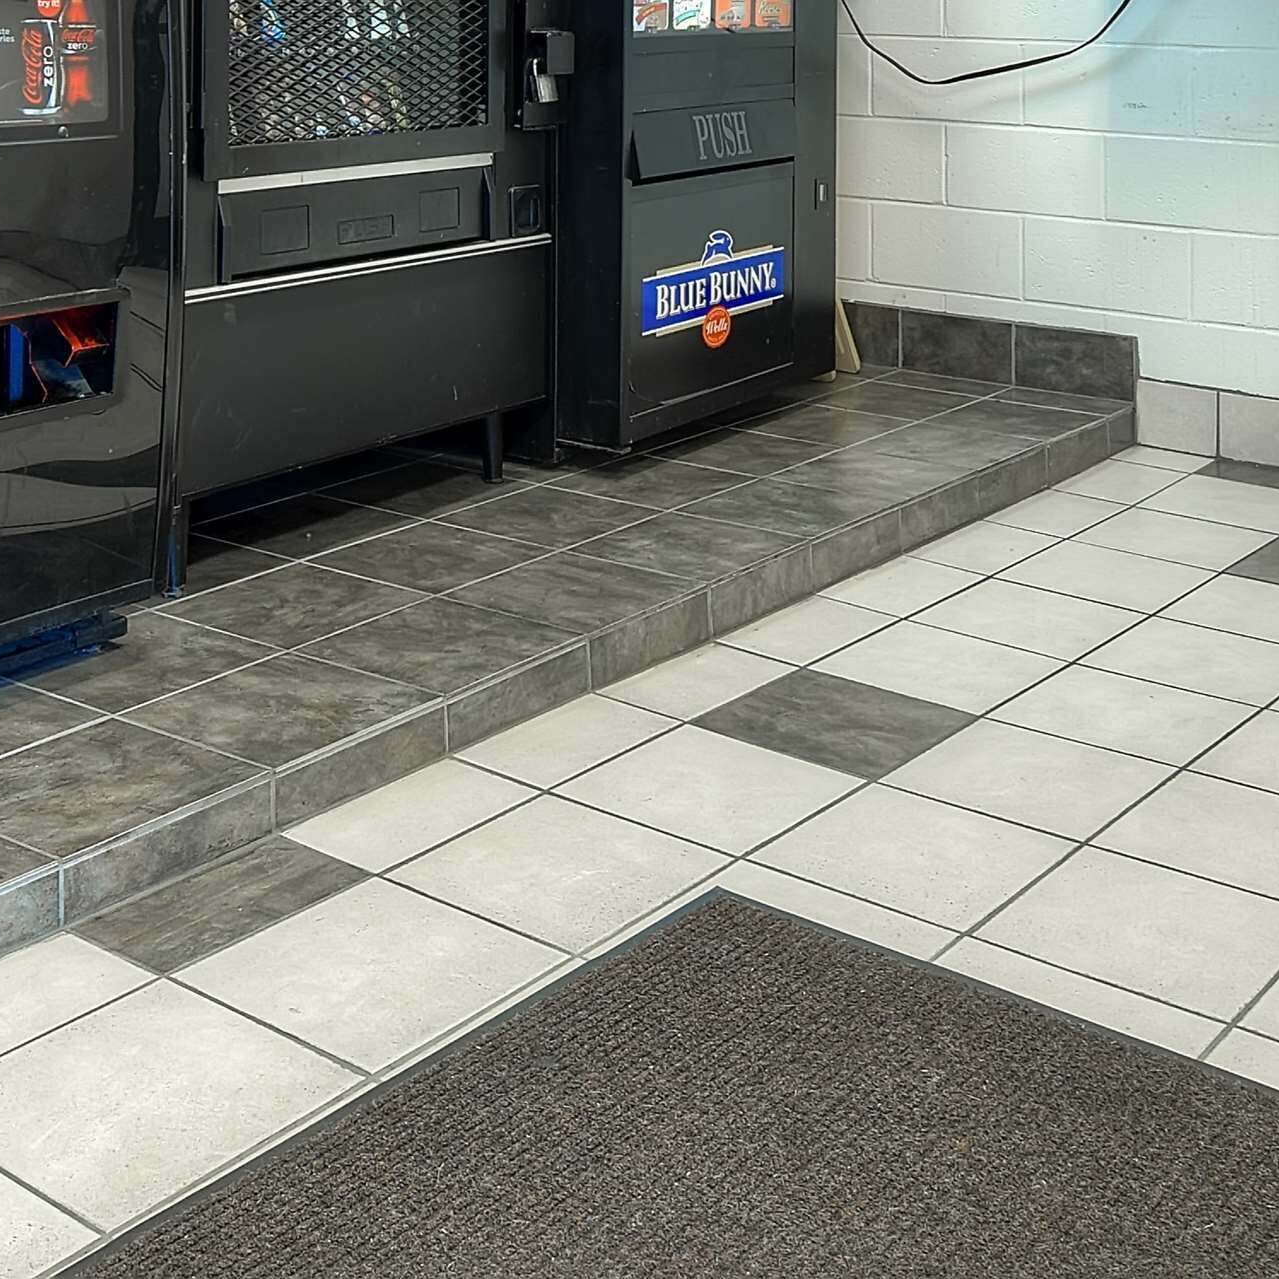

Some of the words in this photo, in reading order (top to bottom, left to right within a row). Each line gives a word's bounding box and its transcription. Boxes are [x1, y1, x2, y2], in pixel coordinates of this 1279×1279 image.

[37, 0, 50, 9] try
[23, 28, 42, 104] Coca-Cola
[43, 46, 53, 87] zero
[67, 42, 88, 51] zero
[692, 111, 752, 162] PUSH
[656, 276, 708, 320] BLUE
[709, 261, 773, 306] BUNNY
